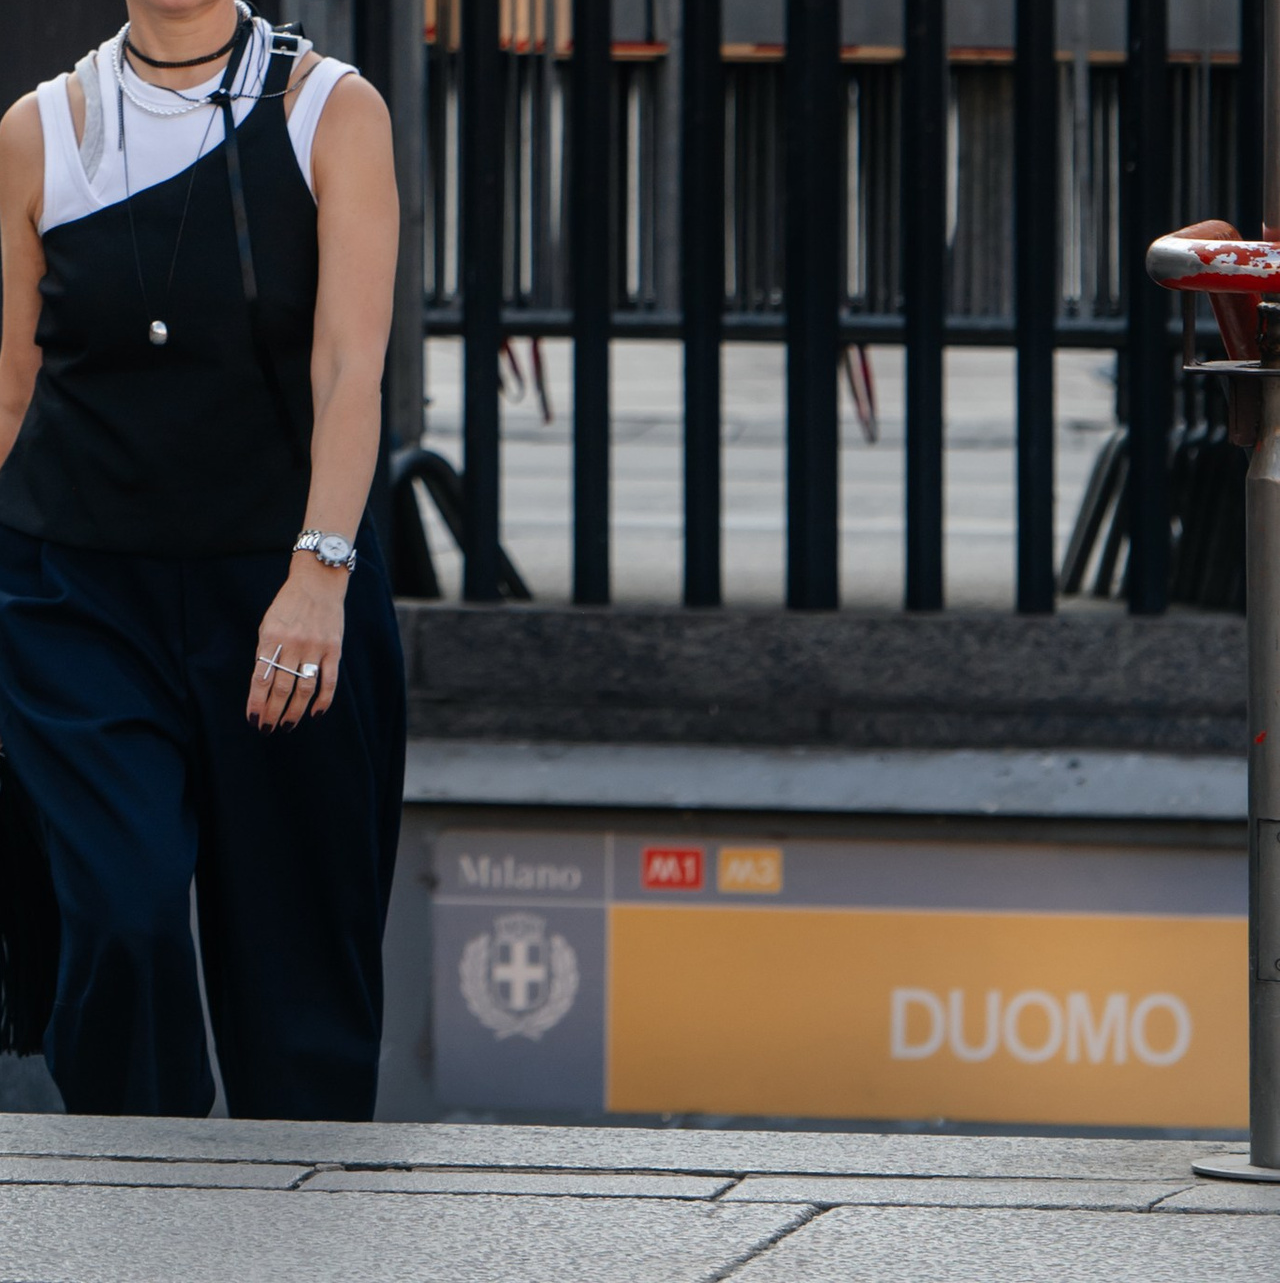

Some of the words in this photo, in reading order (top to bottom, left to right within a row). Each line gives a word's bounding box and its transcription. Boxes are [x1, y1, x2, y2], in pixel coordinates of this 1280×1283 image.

[459, 854, 582, 891] Milano
[647, 855, 698, 884] M1
[727, 856, 775, 886] M3
[889, 988, 1192, 1067] DUOMO
